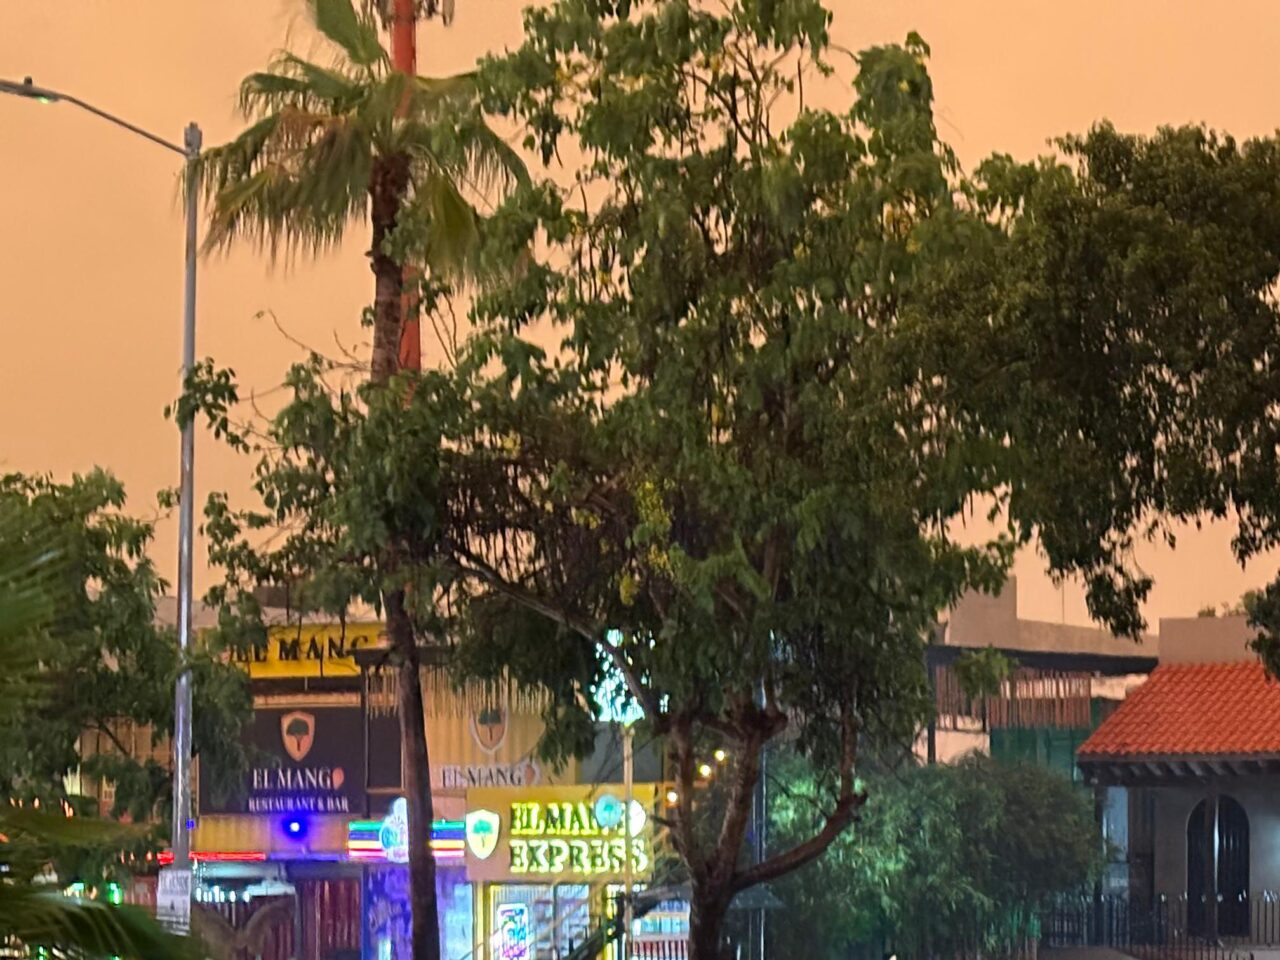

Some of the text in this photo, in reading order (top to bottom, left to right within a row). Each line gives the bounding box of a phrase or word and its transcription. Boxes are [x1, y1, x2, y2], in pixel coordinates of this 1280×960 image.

[252, 767, 273, 789] EL
[510, 802, 545, 835] EL
[509, 838, 648, 875] EXPRESS
